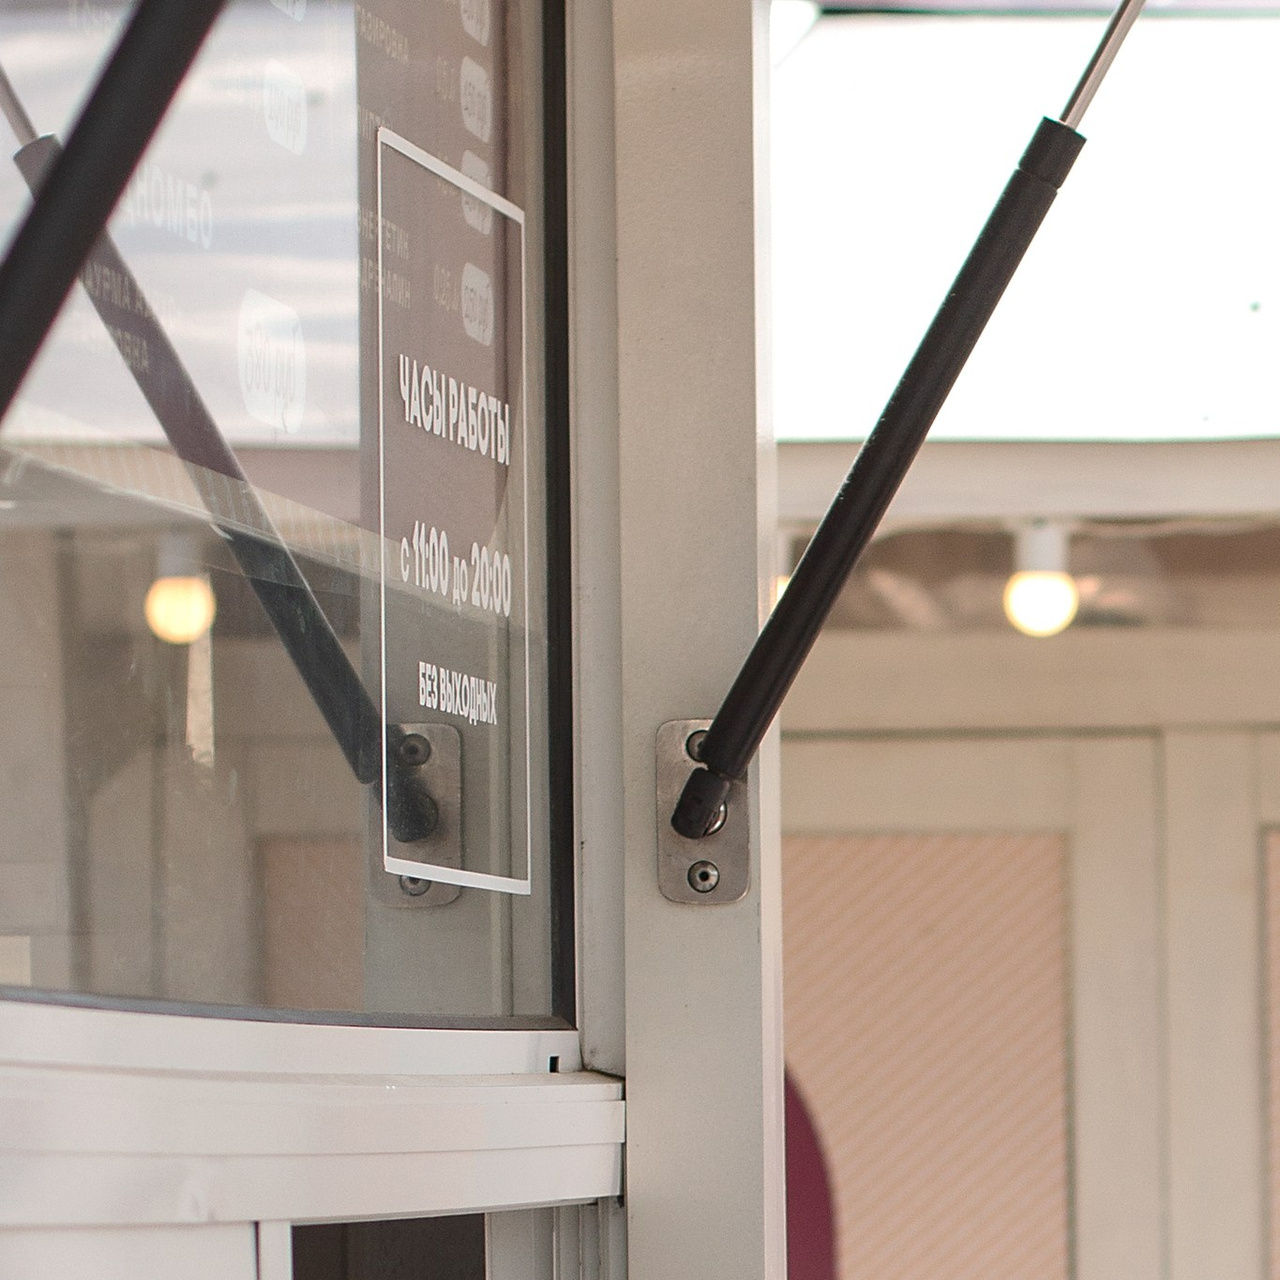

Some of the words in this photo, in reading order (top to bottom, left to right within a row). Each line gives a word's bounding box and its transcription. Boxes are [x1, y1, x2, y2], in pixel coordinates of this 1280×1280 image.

[399, 353, 446, 438] ЧАСЫ
[449, 377, 510, 466] РАБОТЫ
[412, 520, 449, 596] 11:00
[452, 555, 468, 605] до
[471, 541, 511, 617] 20:00
[418, 660, 438, 710] БЕЗ
[439, 667, 497, 725] ВЫХОДНЫХ
